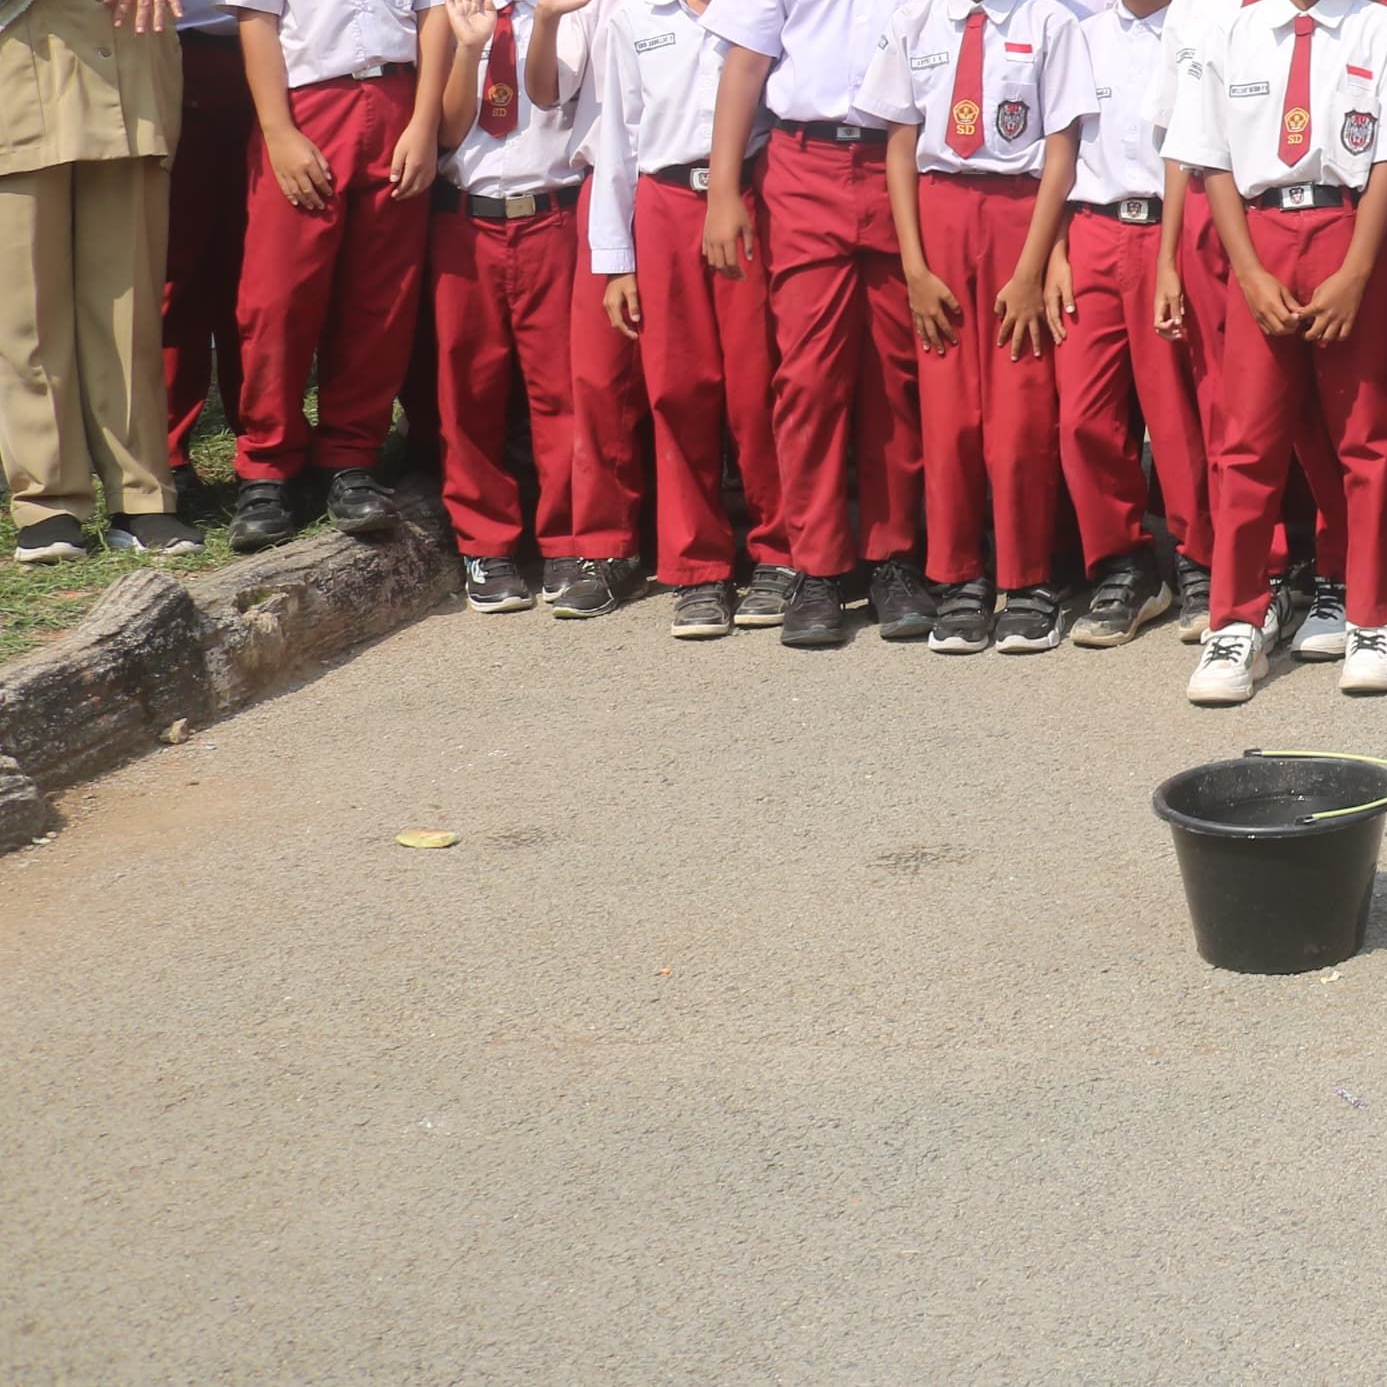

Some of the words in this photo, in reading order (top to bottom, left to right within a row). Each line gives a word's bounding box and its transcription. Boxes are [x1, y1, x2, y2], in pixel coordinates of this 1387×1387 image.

[492, 108, 507, 117] SD
[956, 125, 976, 135] SD
[1287, 134, 1303, 144] SD
